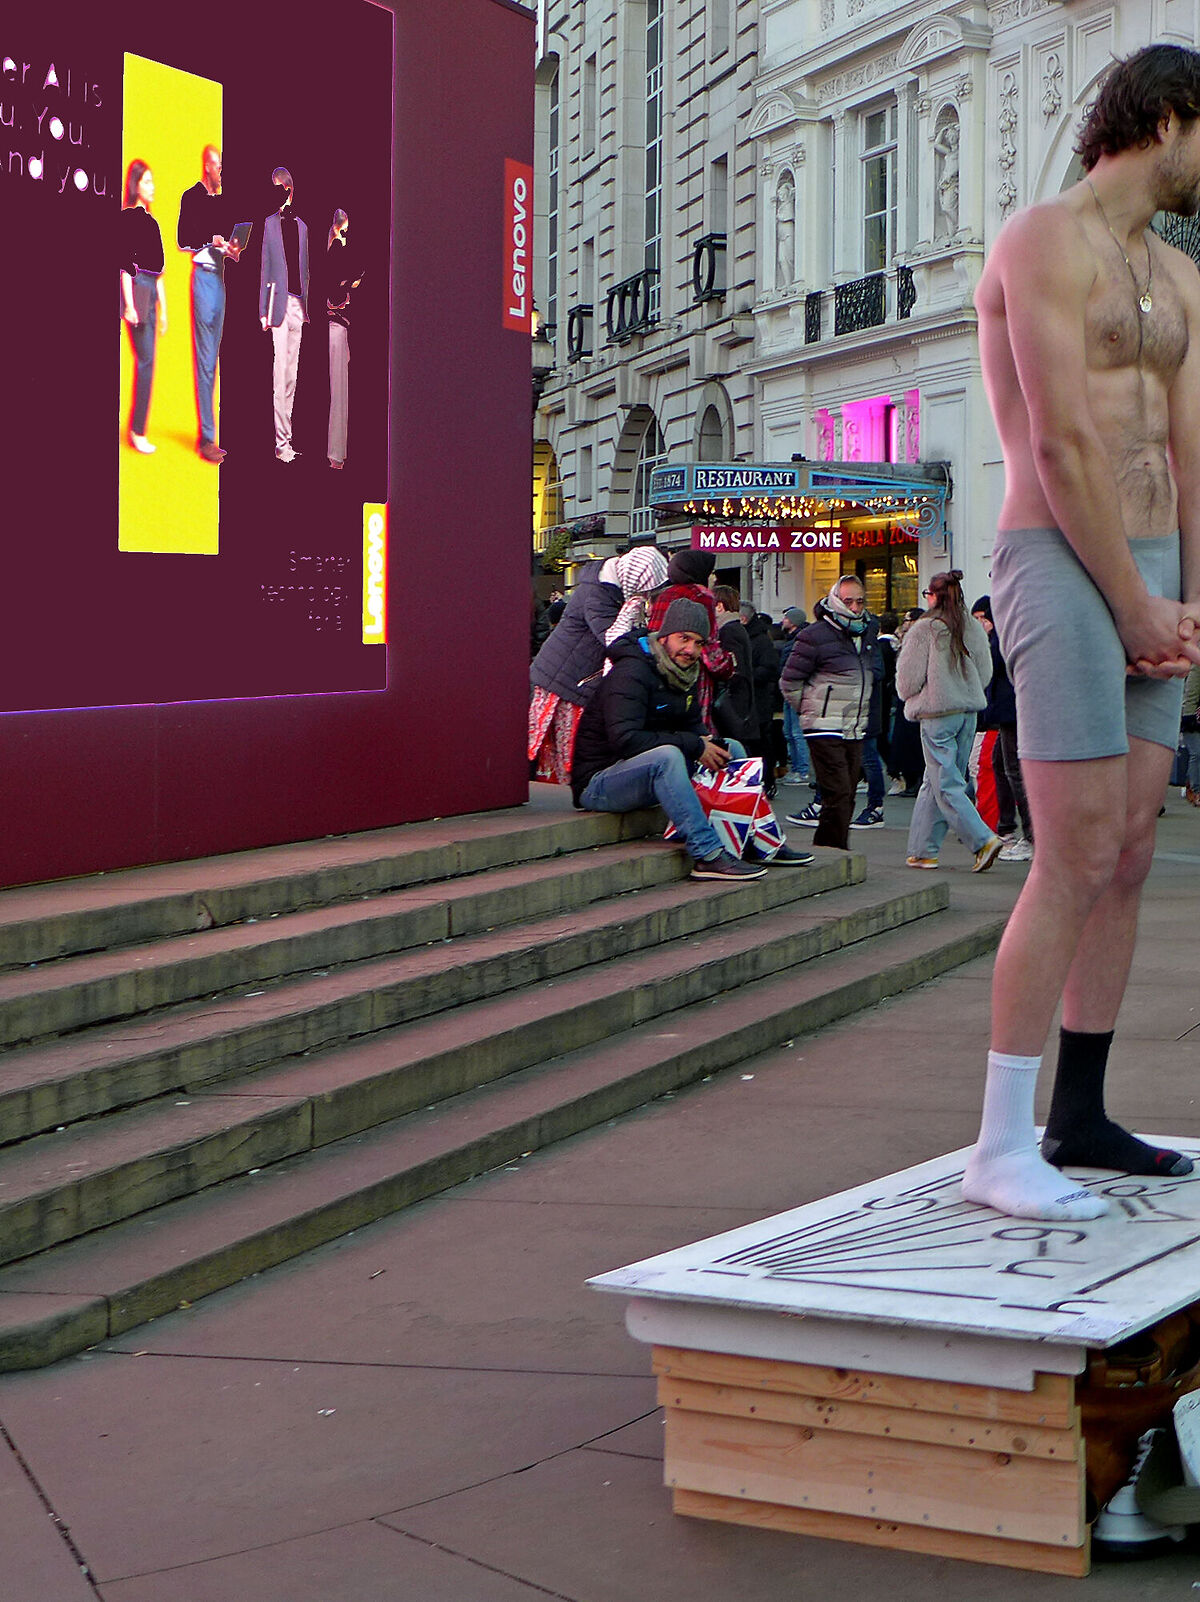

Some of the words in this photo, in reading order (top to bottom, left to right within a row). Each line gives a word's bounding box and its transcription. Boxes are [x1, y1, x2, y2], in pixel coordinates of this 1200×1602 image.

[0, 150, 44, 181] nd
[509, 177, 527, 318] Lenovo
[696, 470, 793, 489] RESTAURANT
[700, 531, 780, 548] MASALA
[790, 531, 842, 548] ZONE
[850, 529, 885, 548] ASALA
[364, 512, 384, 634] Lenovo
